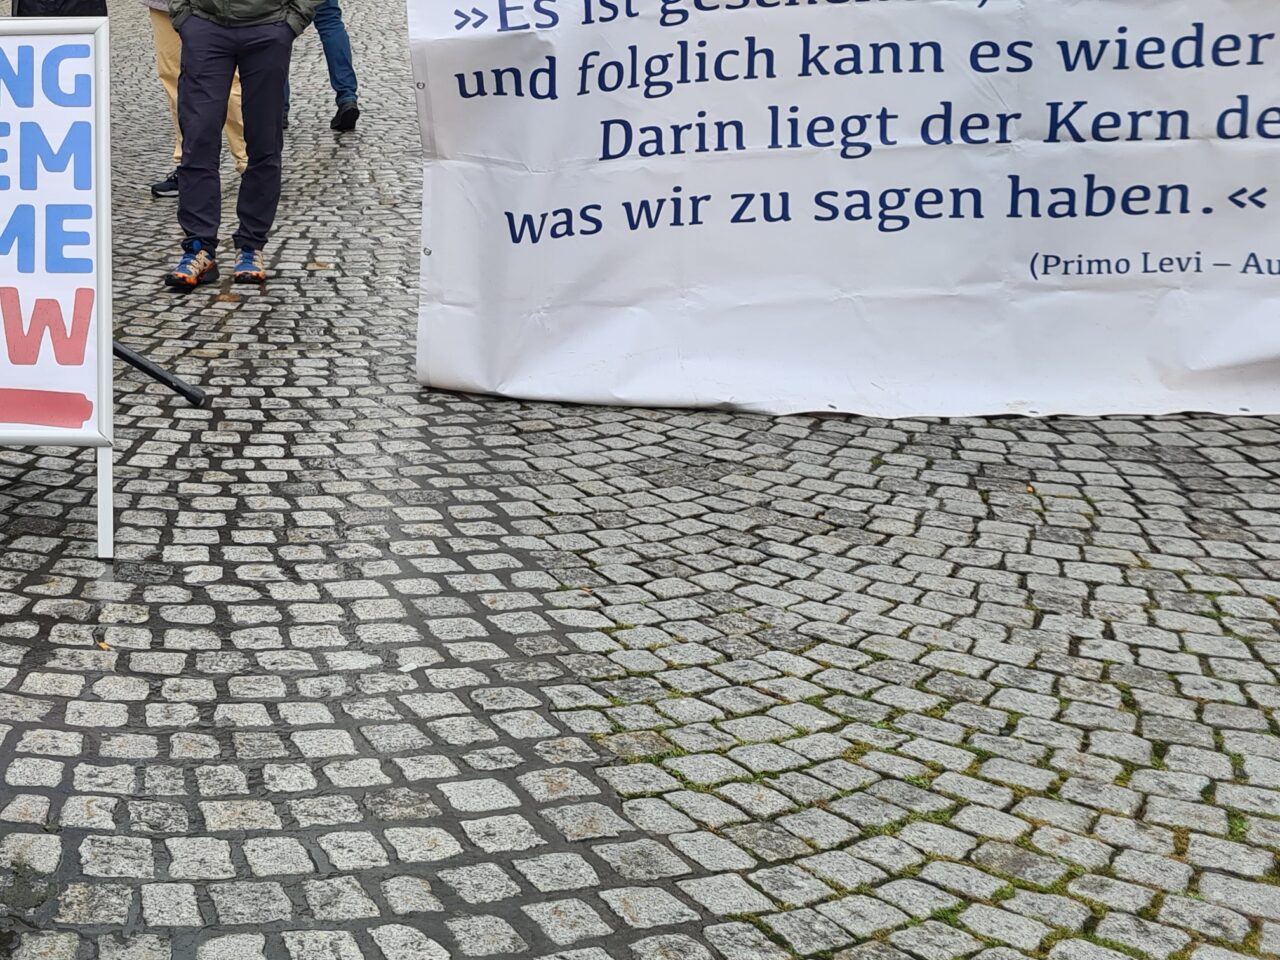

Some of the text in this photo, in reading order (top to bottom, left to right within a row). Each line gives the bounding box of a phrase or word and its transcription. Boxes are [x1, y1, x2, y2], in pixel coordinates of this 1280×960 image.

[454, 22, 1276, 100] und folglich kann es wieder
[598, 94, 1280, 161] Darin liegt der Kern de
[504, 201, 603, 244] was
[622, 185, 711, 231] wir
[730, 190, 791, 224] zu
[813, 186, 984, 233] sagen
[1029, 252, 1131, 280] (Primo
[1141, 251, 1203, 274] Levi
[1240, 253, 1280, 276] Au
